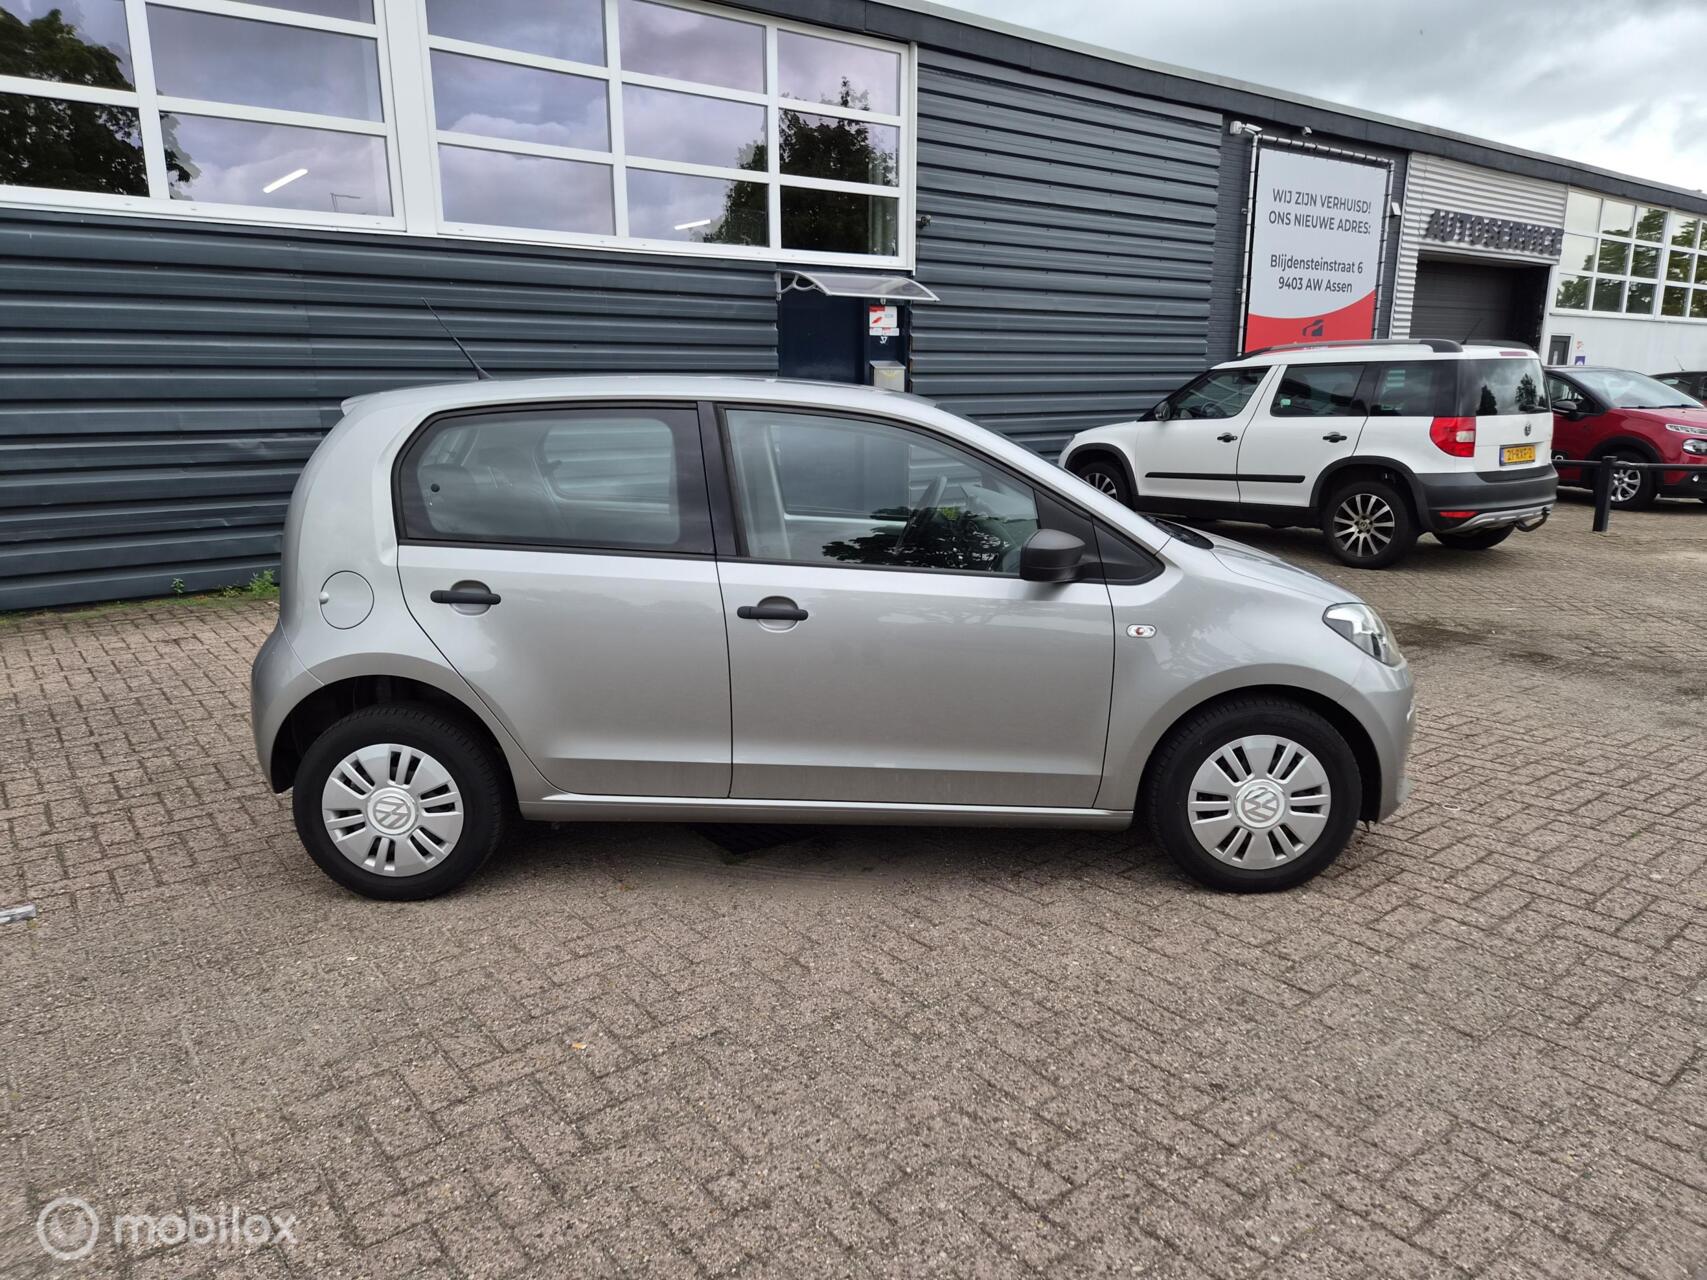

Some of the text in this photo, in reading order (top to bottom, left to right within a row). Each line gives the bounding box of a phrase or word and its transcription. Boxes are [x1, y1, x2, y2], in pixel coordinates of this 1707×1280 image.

[1272, 188, 1372, 214] WIJ ZIJN VERHUISD!
[1268, 210, 1371, 235] ONS NIEUWE ADRES:
[1423, 209, 1564, 256] AUTOSERVICE
[1270, 253, 1364, 274] Blijdensteinstraat 6
[1278, 276, 1353, 293] 9403 AW Assen
